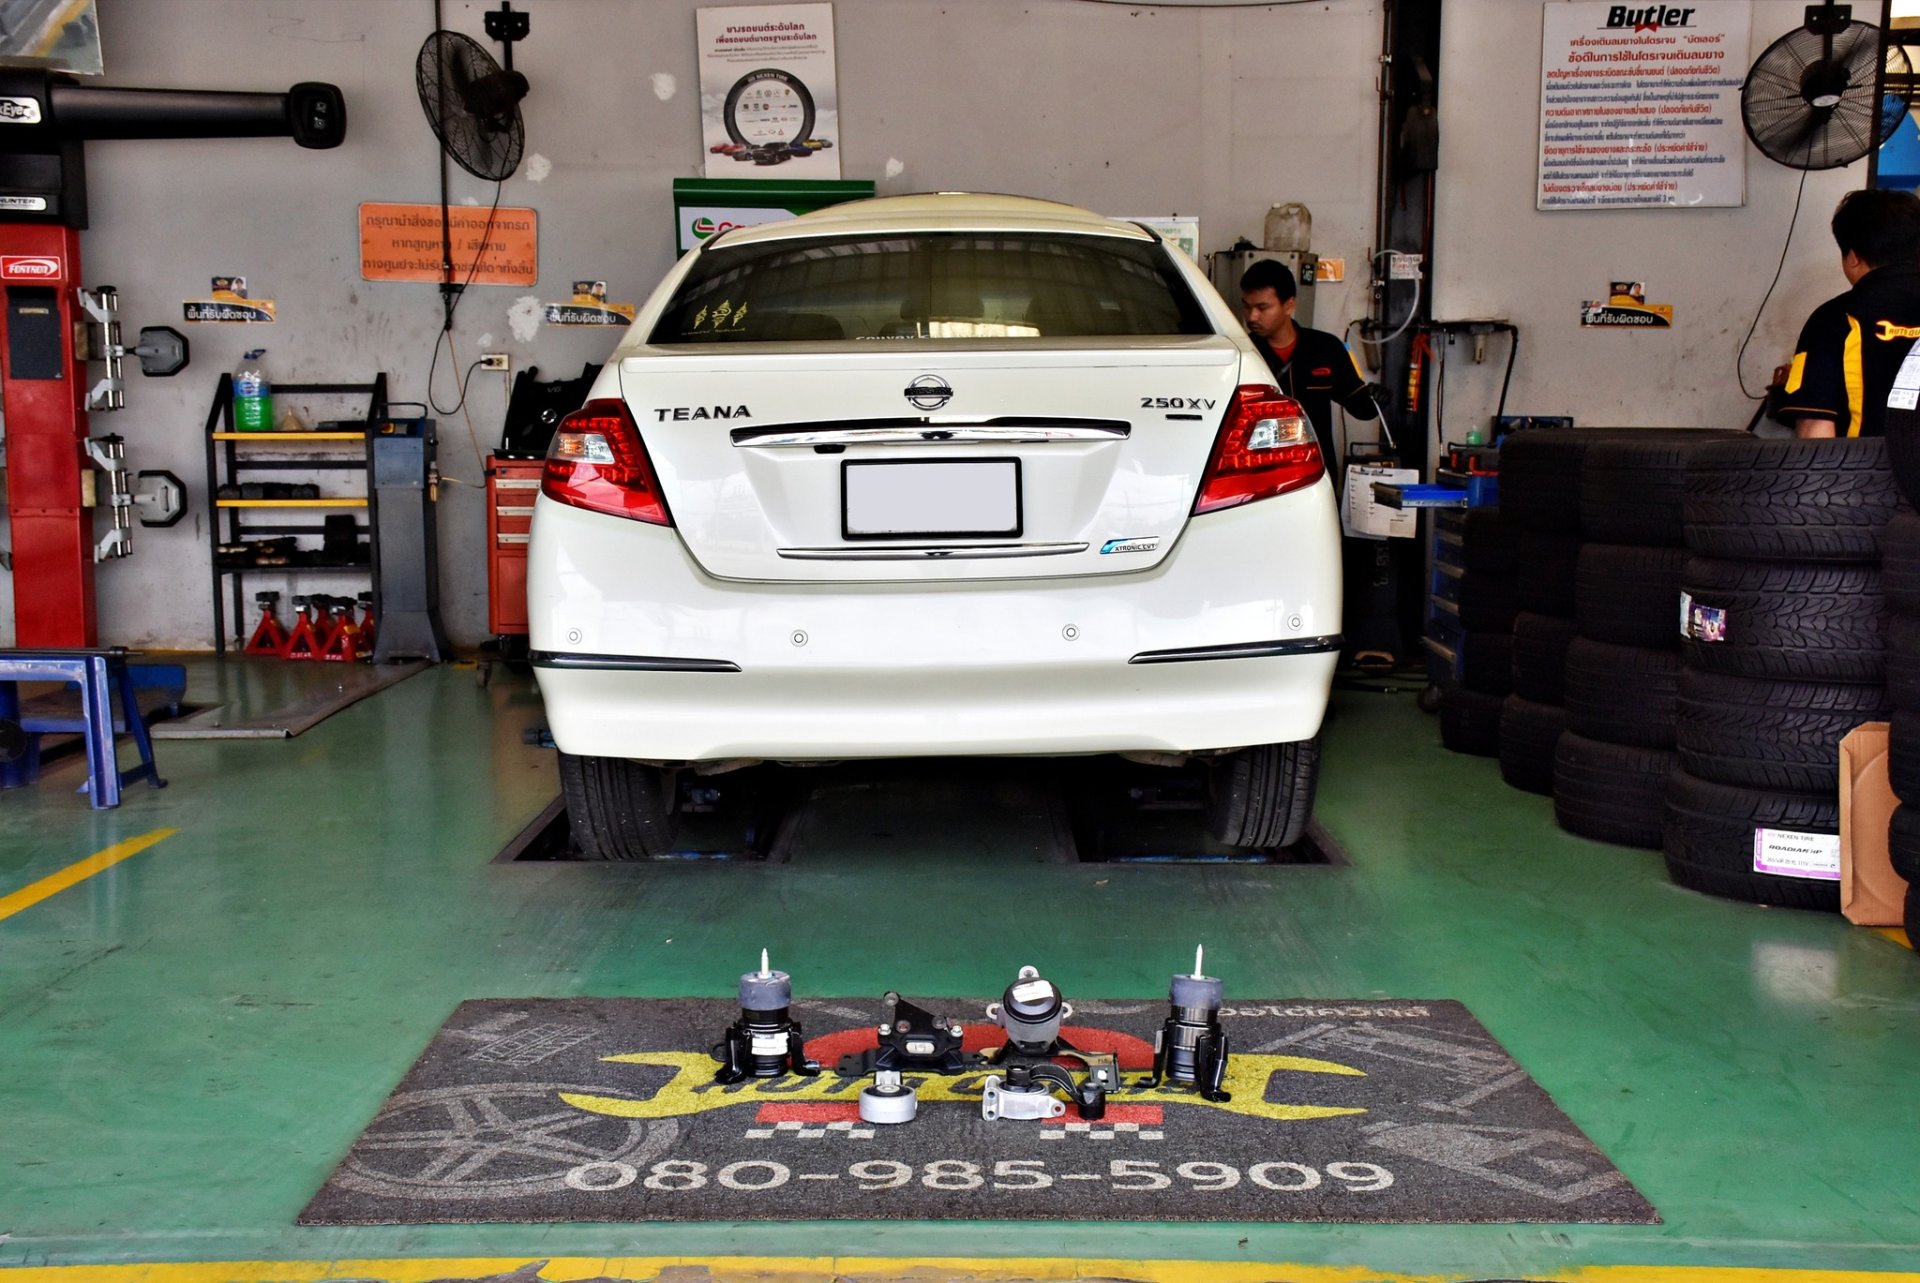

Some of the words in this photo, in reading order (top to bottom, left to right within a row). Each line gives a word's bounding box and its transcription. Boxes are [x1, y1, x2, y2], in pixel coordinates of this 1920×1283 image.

[1606, 5, 1696, 28] Butler
[654, 405, 752, 422] TEANA
[1777, 833, 1799, 841] NEXEN
[1768, 844, 1809, 854] ROADIAN
[563, 1159, 1396, 1192] 080-985-5909
